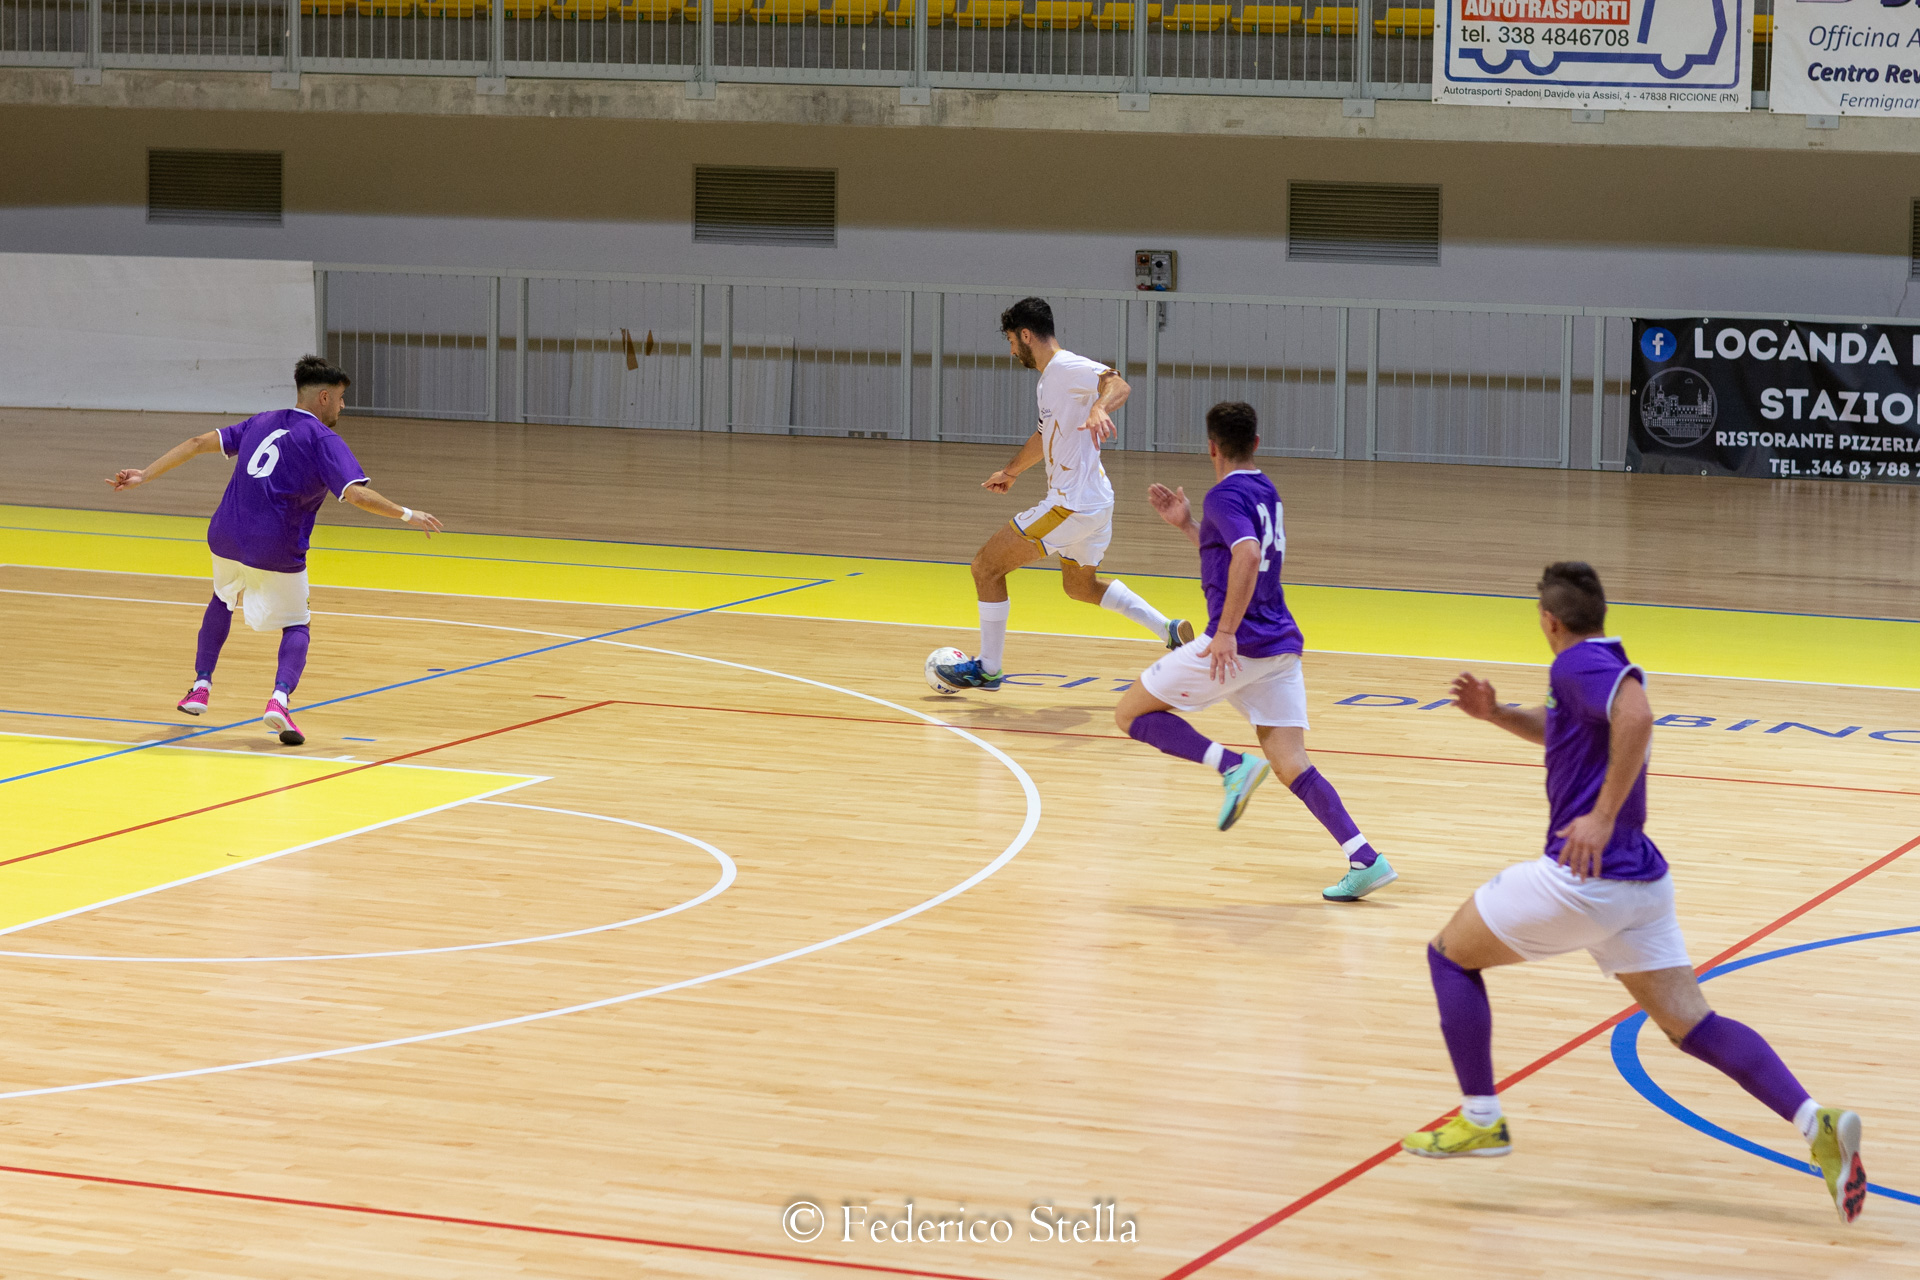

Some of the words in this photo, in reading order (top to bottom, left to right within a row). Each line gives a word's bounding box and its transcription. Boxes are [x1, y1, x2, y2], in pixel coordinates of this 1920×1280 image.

[1465, 0, 1628, 20] AUTOTRASPORTI
[1461, 26, 1491, 43] tel.
[1498, 26, 1535, 44] 338
[1541, 28, 1630, 47] 4846708
[1809, 25, 1900, 51] Officina
[1808, 62, 1880, 82] Centro
[1443, 86, 1502, 97] Autotrasporti
[1504, 87, 1541, 98] Spadoni
[1544, 89, 1575, 99] Davide
[1577, 90, 1590, 99] via
[1592, 91, 1622, 100] Assisi,
[1624, 91, 1631, 100] 4
[1640, 92, 1667, 101] 47838
[1669, 92, 1717, 102] RICCIONE
[1719, 93, 1739, 103] (RN)
[1694, 327, 1899, 366] LOCANDA
[1760, 387, 1920, 425] STAZIO
[1716, 431, 1834, 449] RISTORANTE
[247, 428, 290, 478] 6
[1769, 458, 1800, 475] TEL
[1848, 461, 1871, 476] 03
[1876, 462, 1910, 477] 788
[1256, 501, 1287, 573] 24
